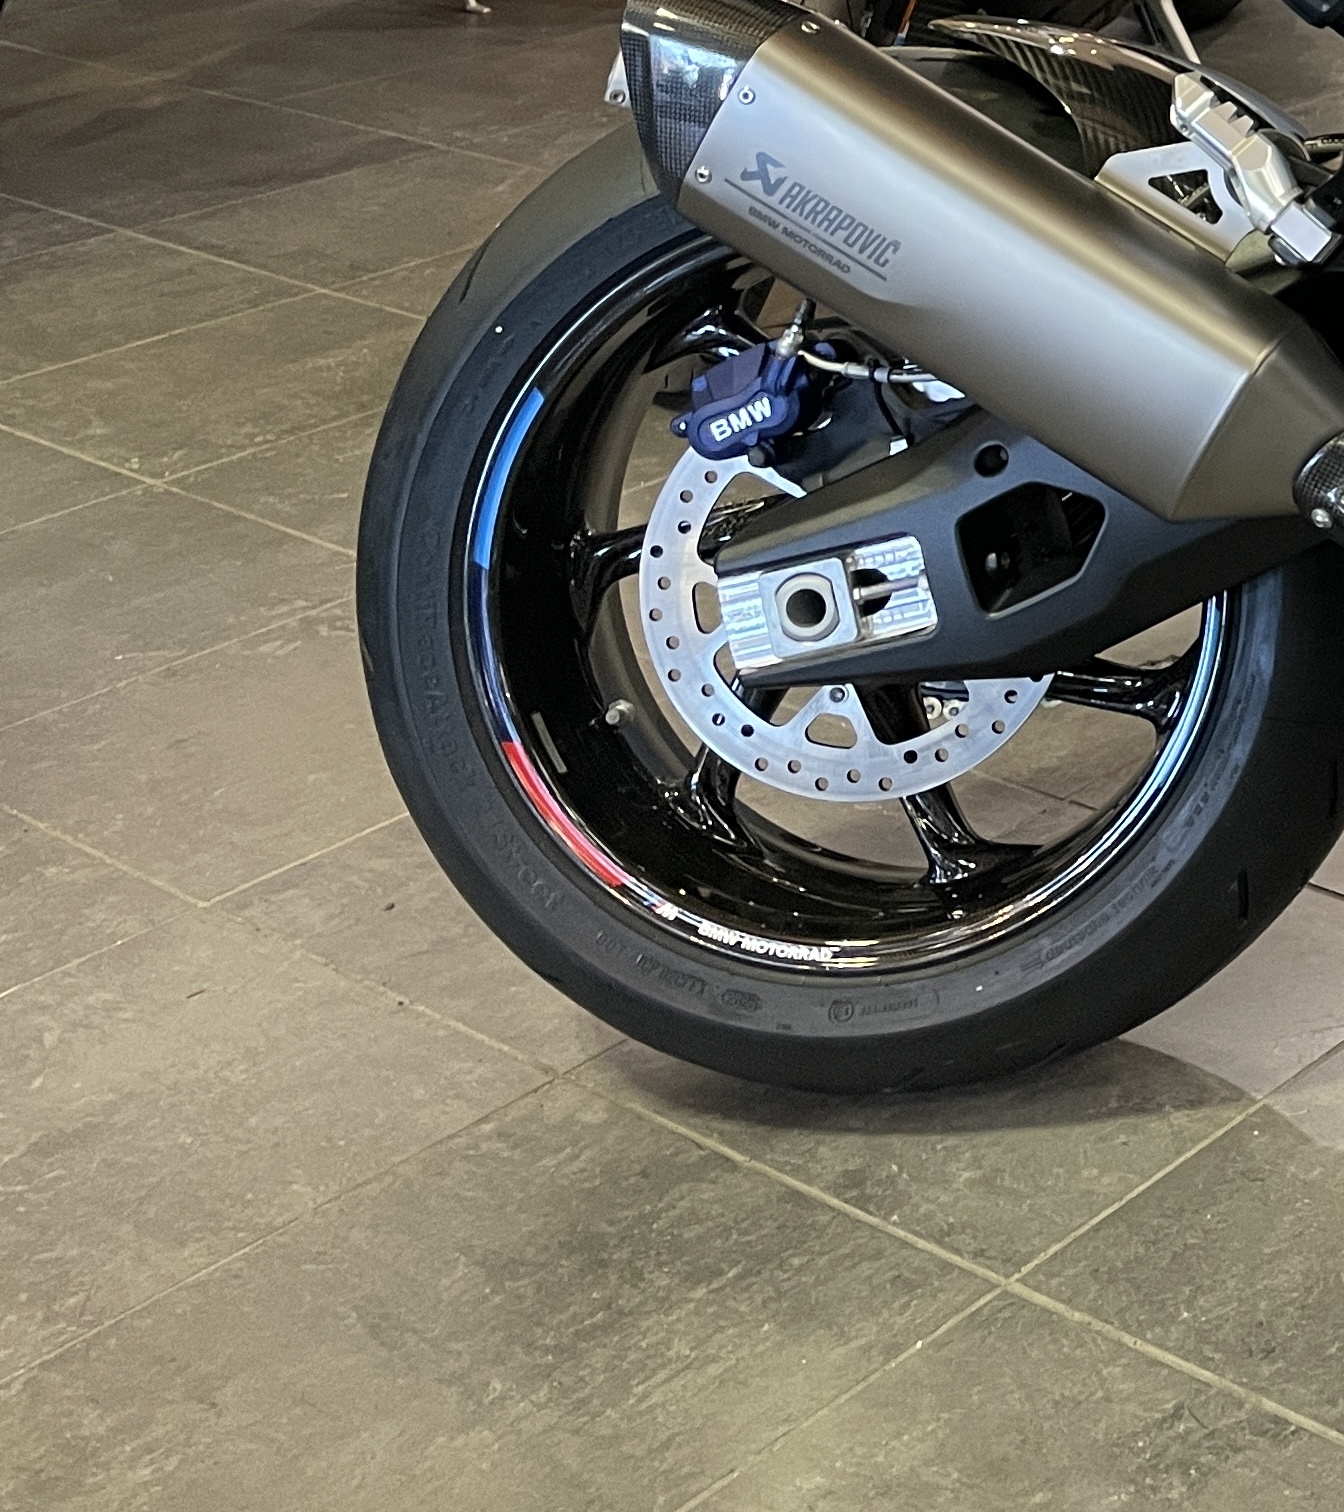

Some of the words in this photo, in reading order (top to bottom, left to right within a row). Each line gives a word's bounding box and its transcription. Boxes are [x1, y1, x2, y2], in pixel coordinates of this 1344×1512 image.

[748, 205, 780, 230] BMW
[780, 226, 851, 274] MOTORRAD
[709, 396, 772, 442] BMW
[698, 922, 742, 946] BMW
[740, 937, 834, 963] MOTORRAD
